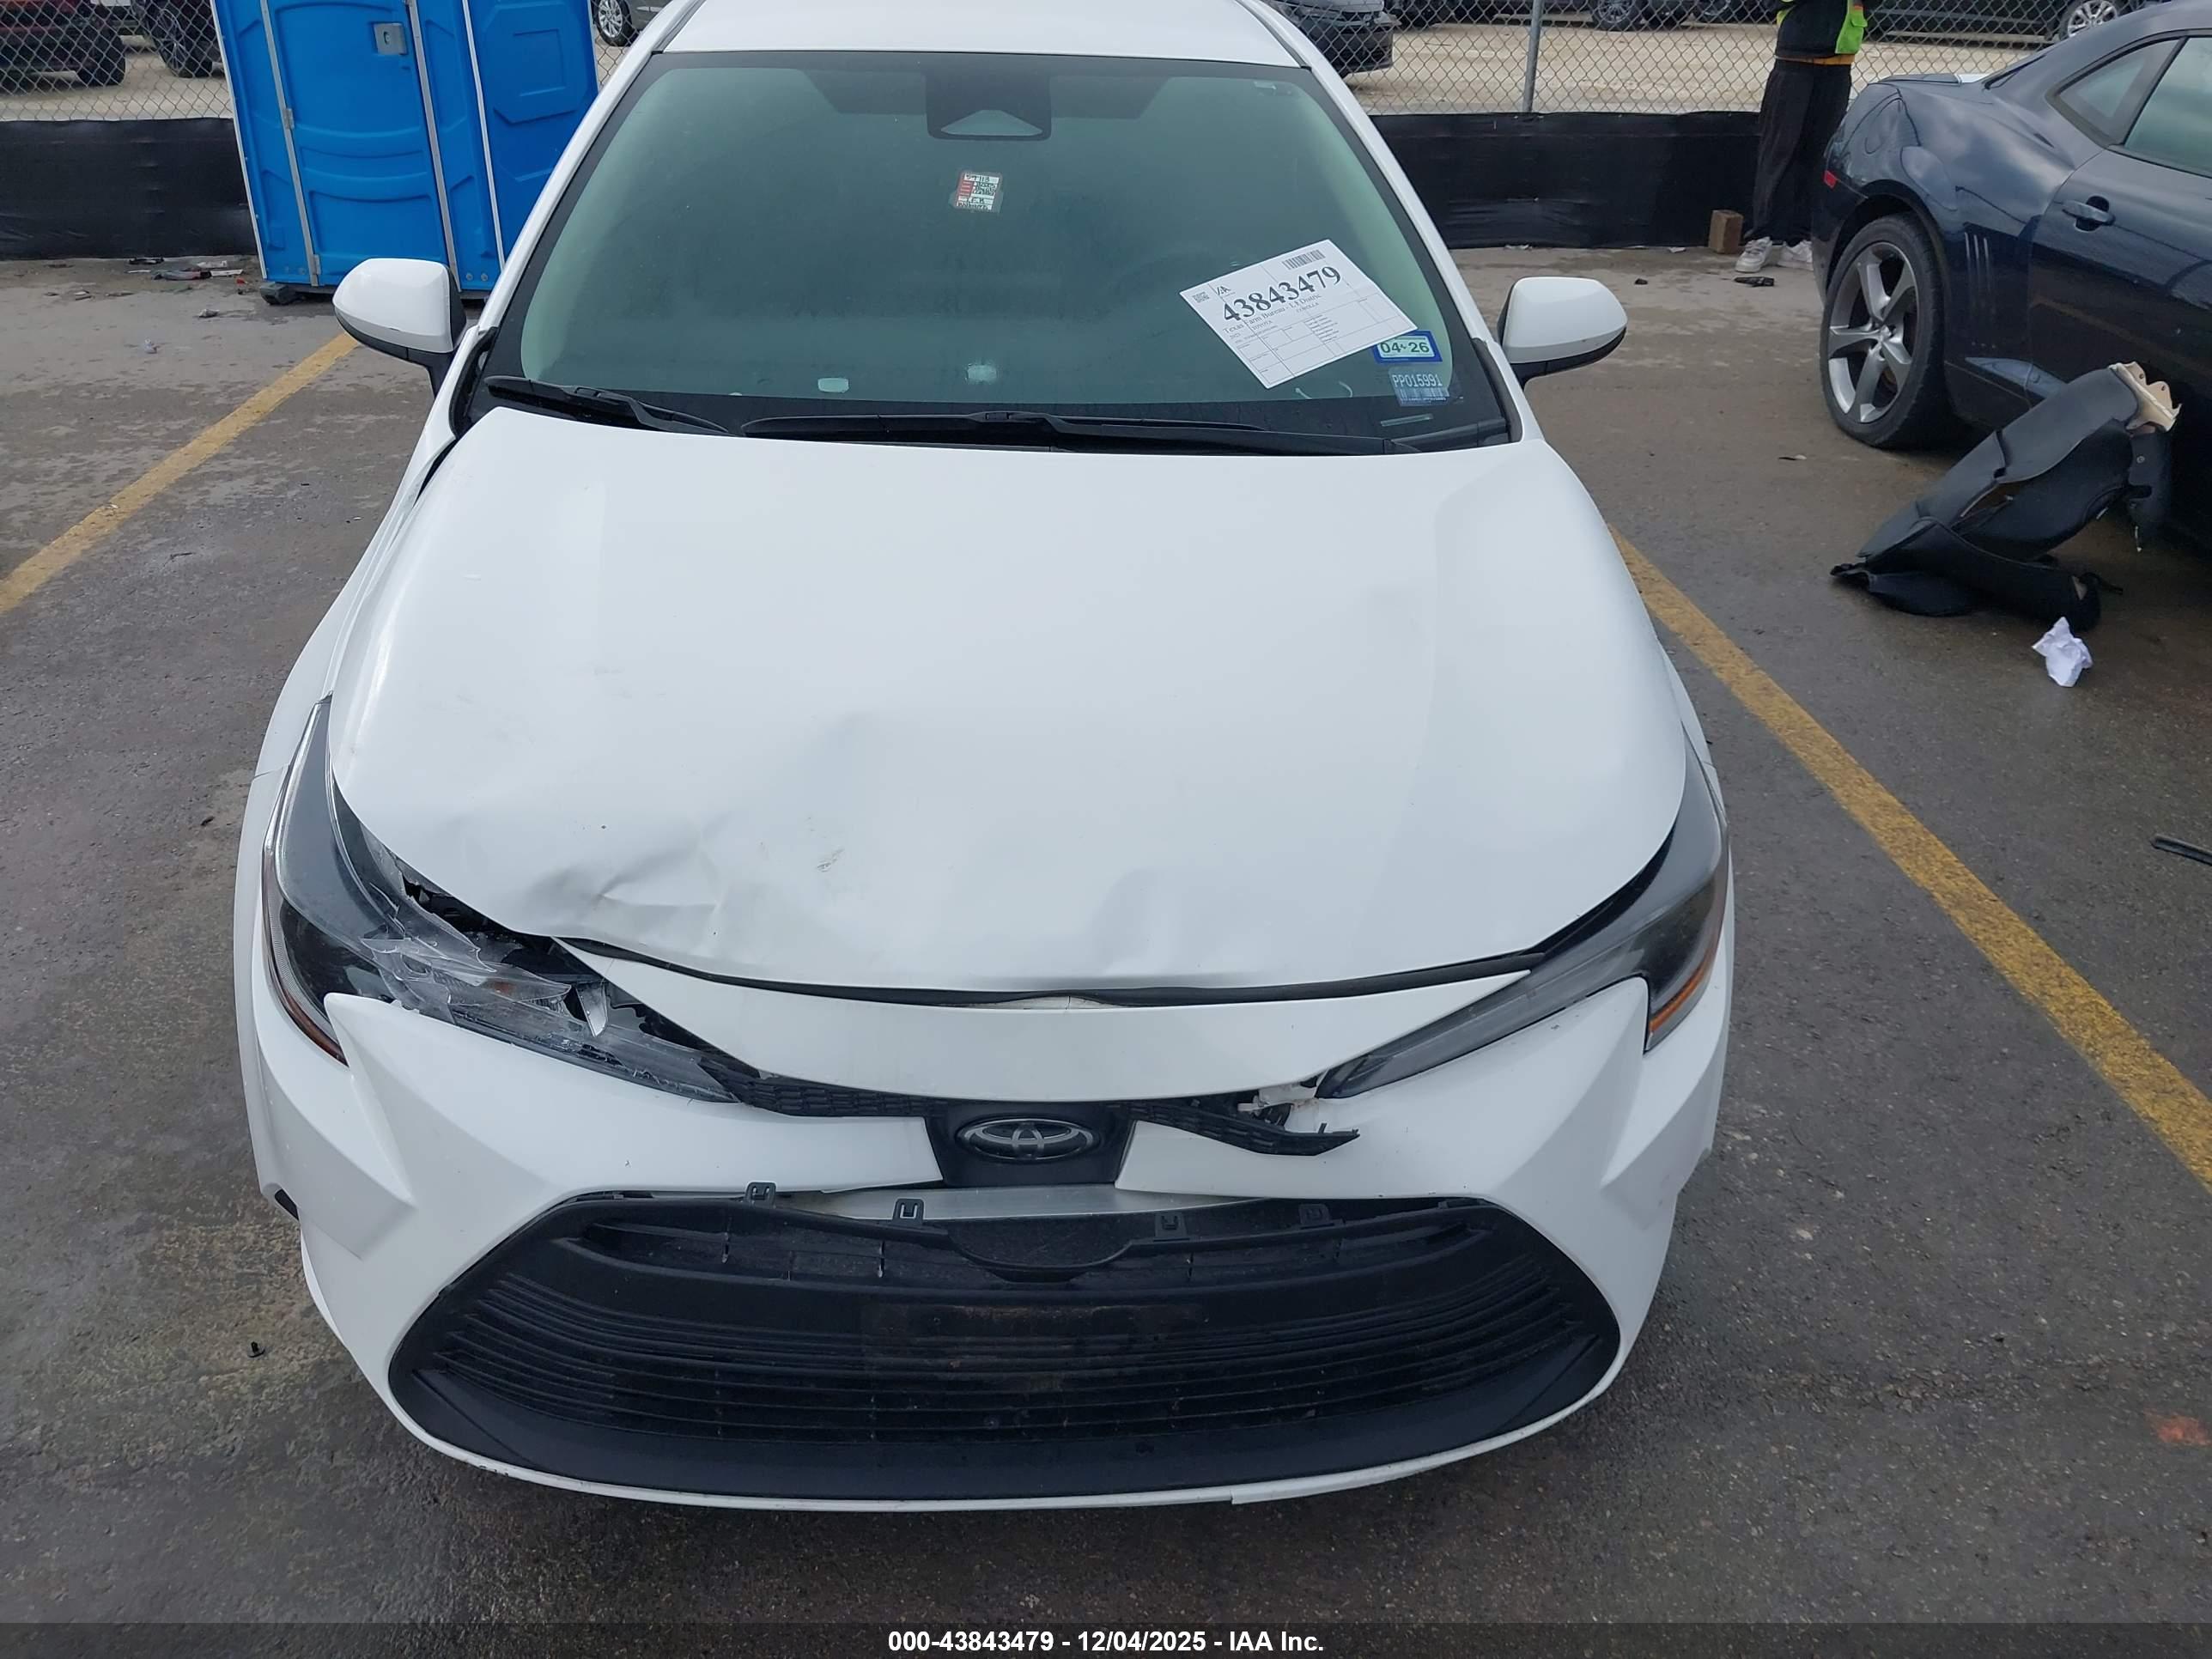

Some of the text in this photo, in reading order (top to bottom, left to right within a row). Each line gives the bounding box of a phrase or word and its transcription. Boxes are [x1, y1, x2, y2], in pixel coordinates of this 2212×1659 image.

[1223, 266, 1341, 322] 43843479
[1223, 322, 1244, 334] Texas
[1262, 307, 1285, 319] Bureau
[1380, 342, 1430, 354] 04 26
